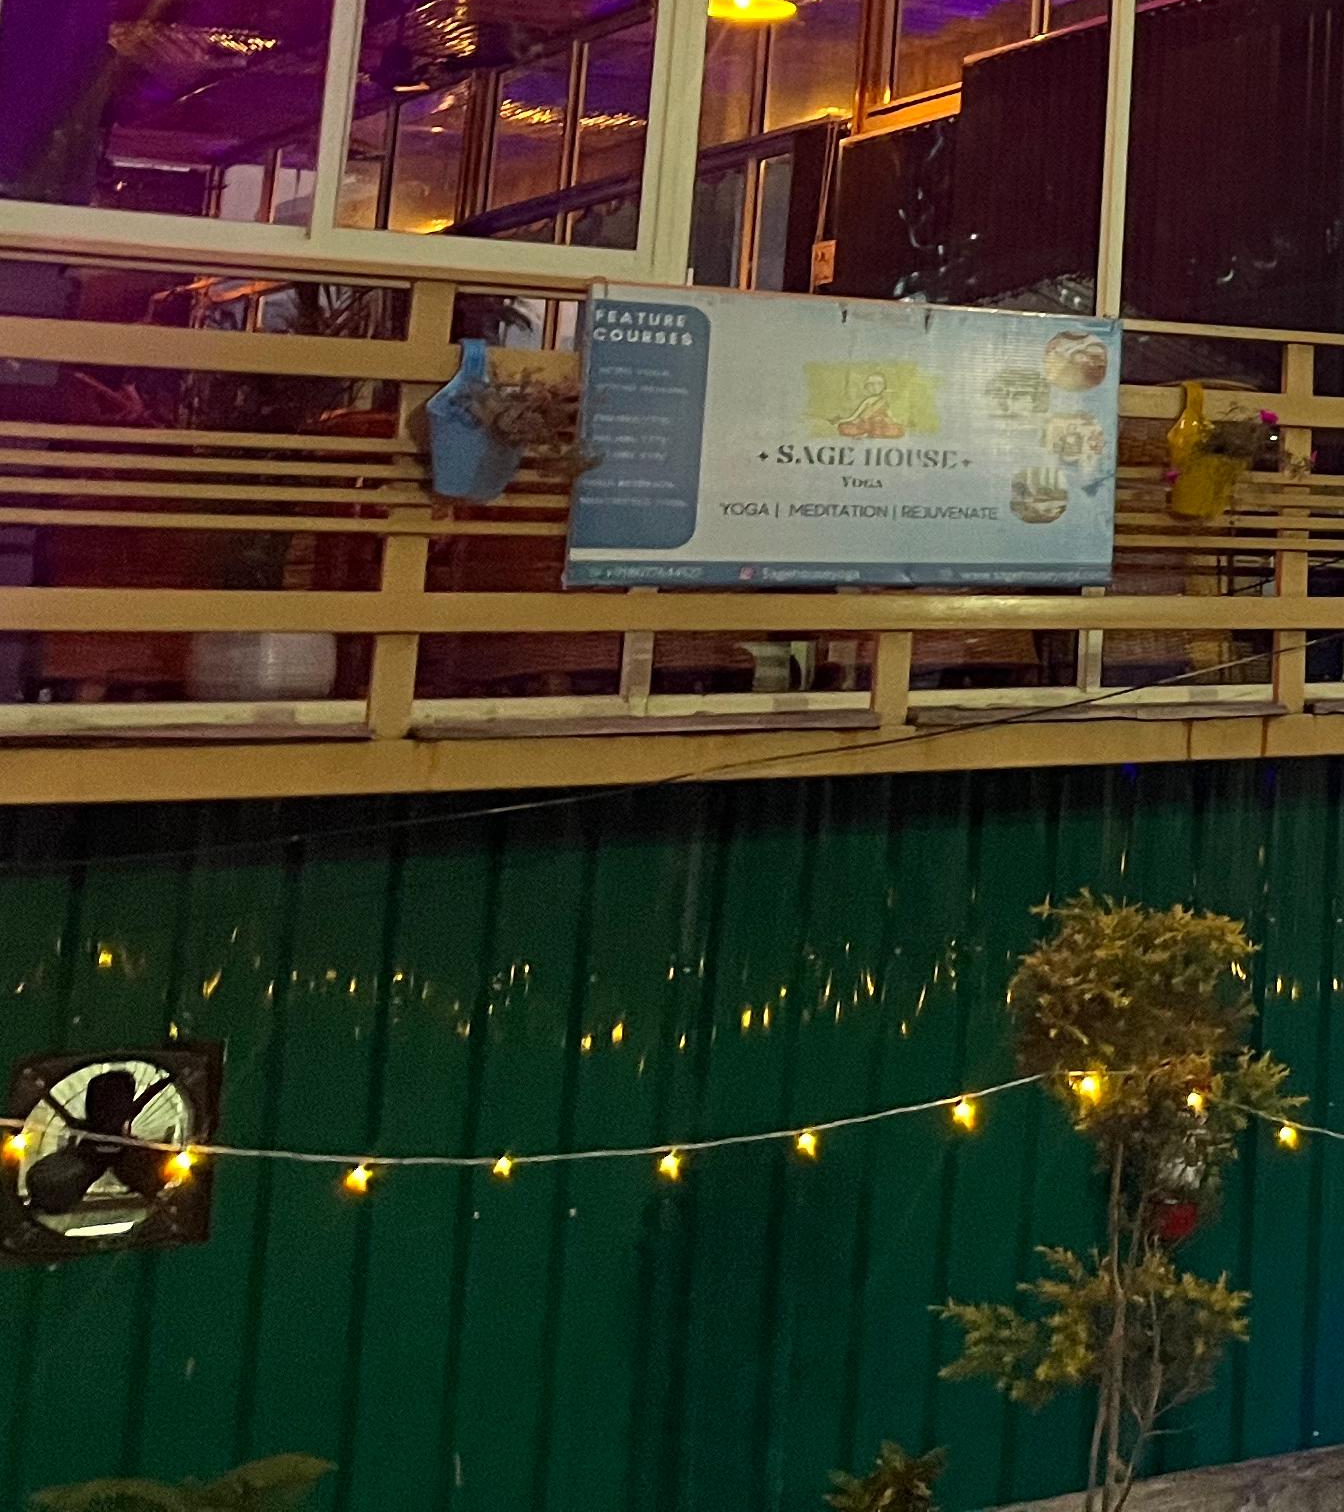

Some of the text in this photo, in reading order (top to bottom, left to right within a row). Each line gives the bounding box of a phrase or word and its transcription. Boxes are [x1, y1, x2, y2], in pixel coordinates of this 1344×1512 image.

[595, 309, 688, 328] FEATURE
[592, 327, 693, 347] COURSES
[776, 443, 959, 469] SAGE HOUSE
[719, 502, 999, 521] YOGA MEDITATION REJUVENATE
